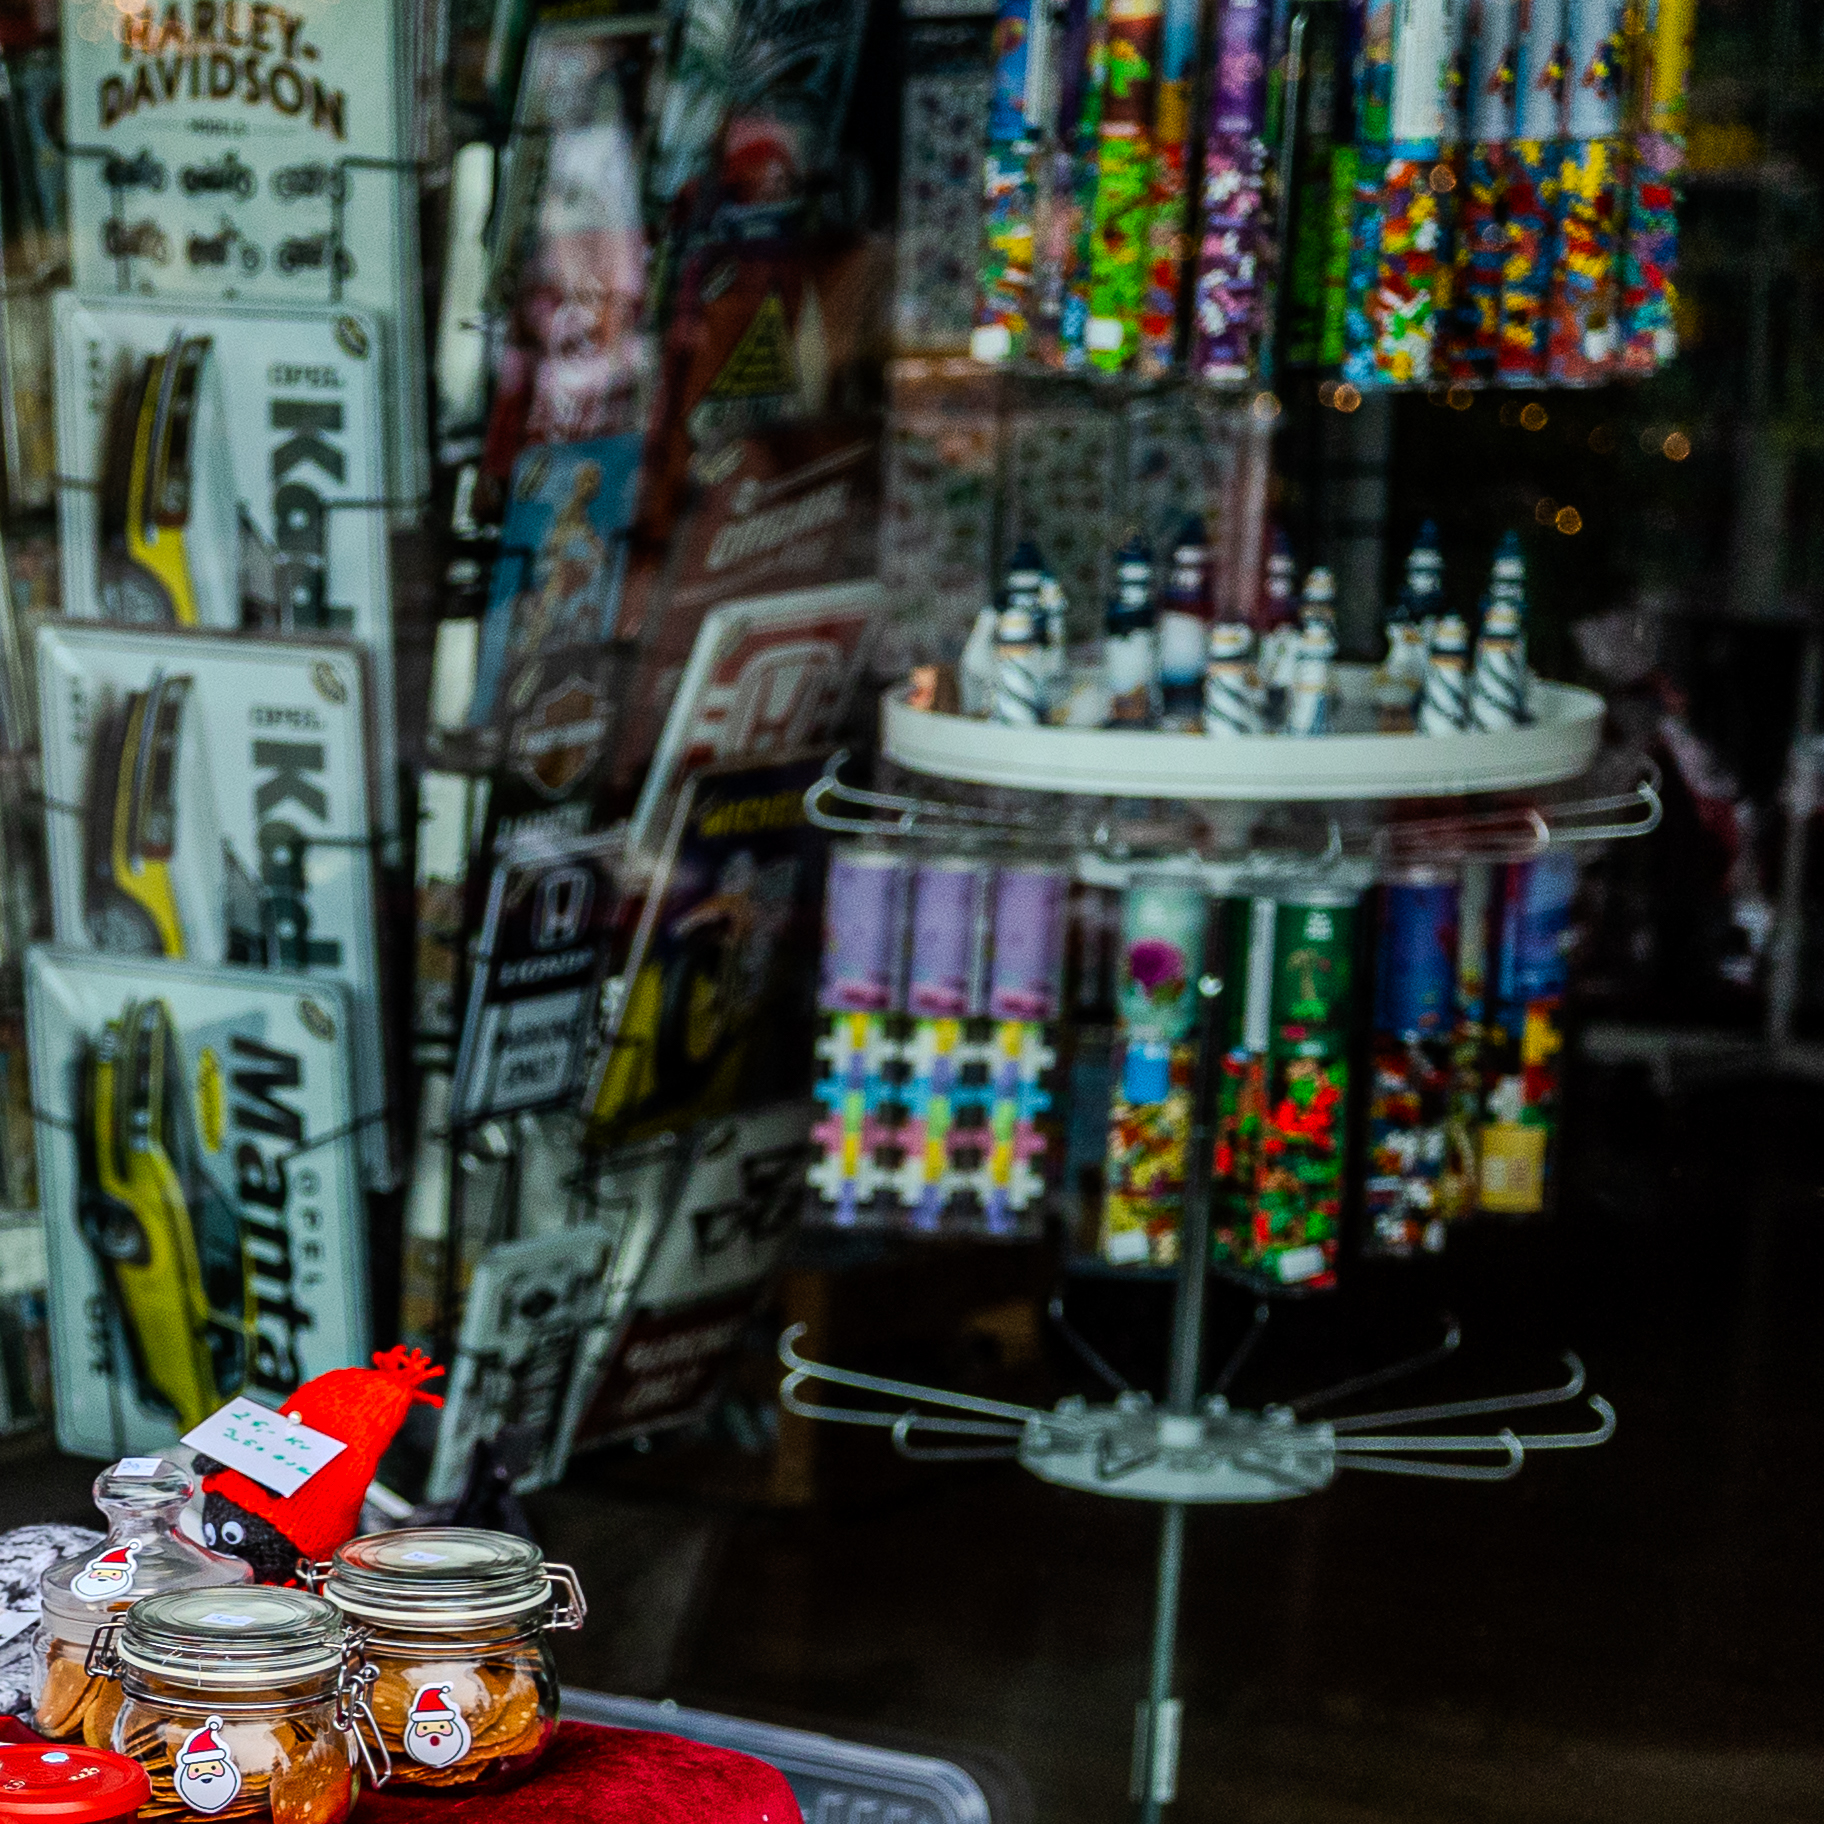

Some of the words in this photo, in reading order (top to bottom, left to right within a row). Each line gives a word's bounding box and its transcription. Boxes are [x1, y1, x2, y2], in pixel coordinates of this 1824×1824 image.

[98, 50, 350, 143] DAVIDSON
[267, 398, 356, 628] Kad
[252, 738, 342, 970] Kad
[229, 1035, 312, 1396] Manta
[297, 1170, 326, 1290] OPEL
